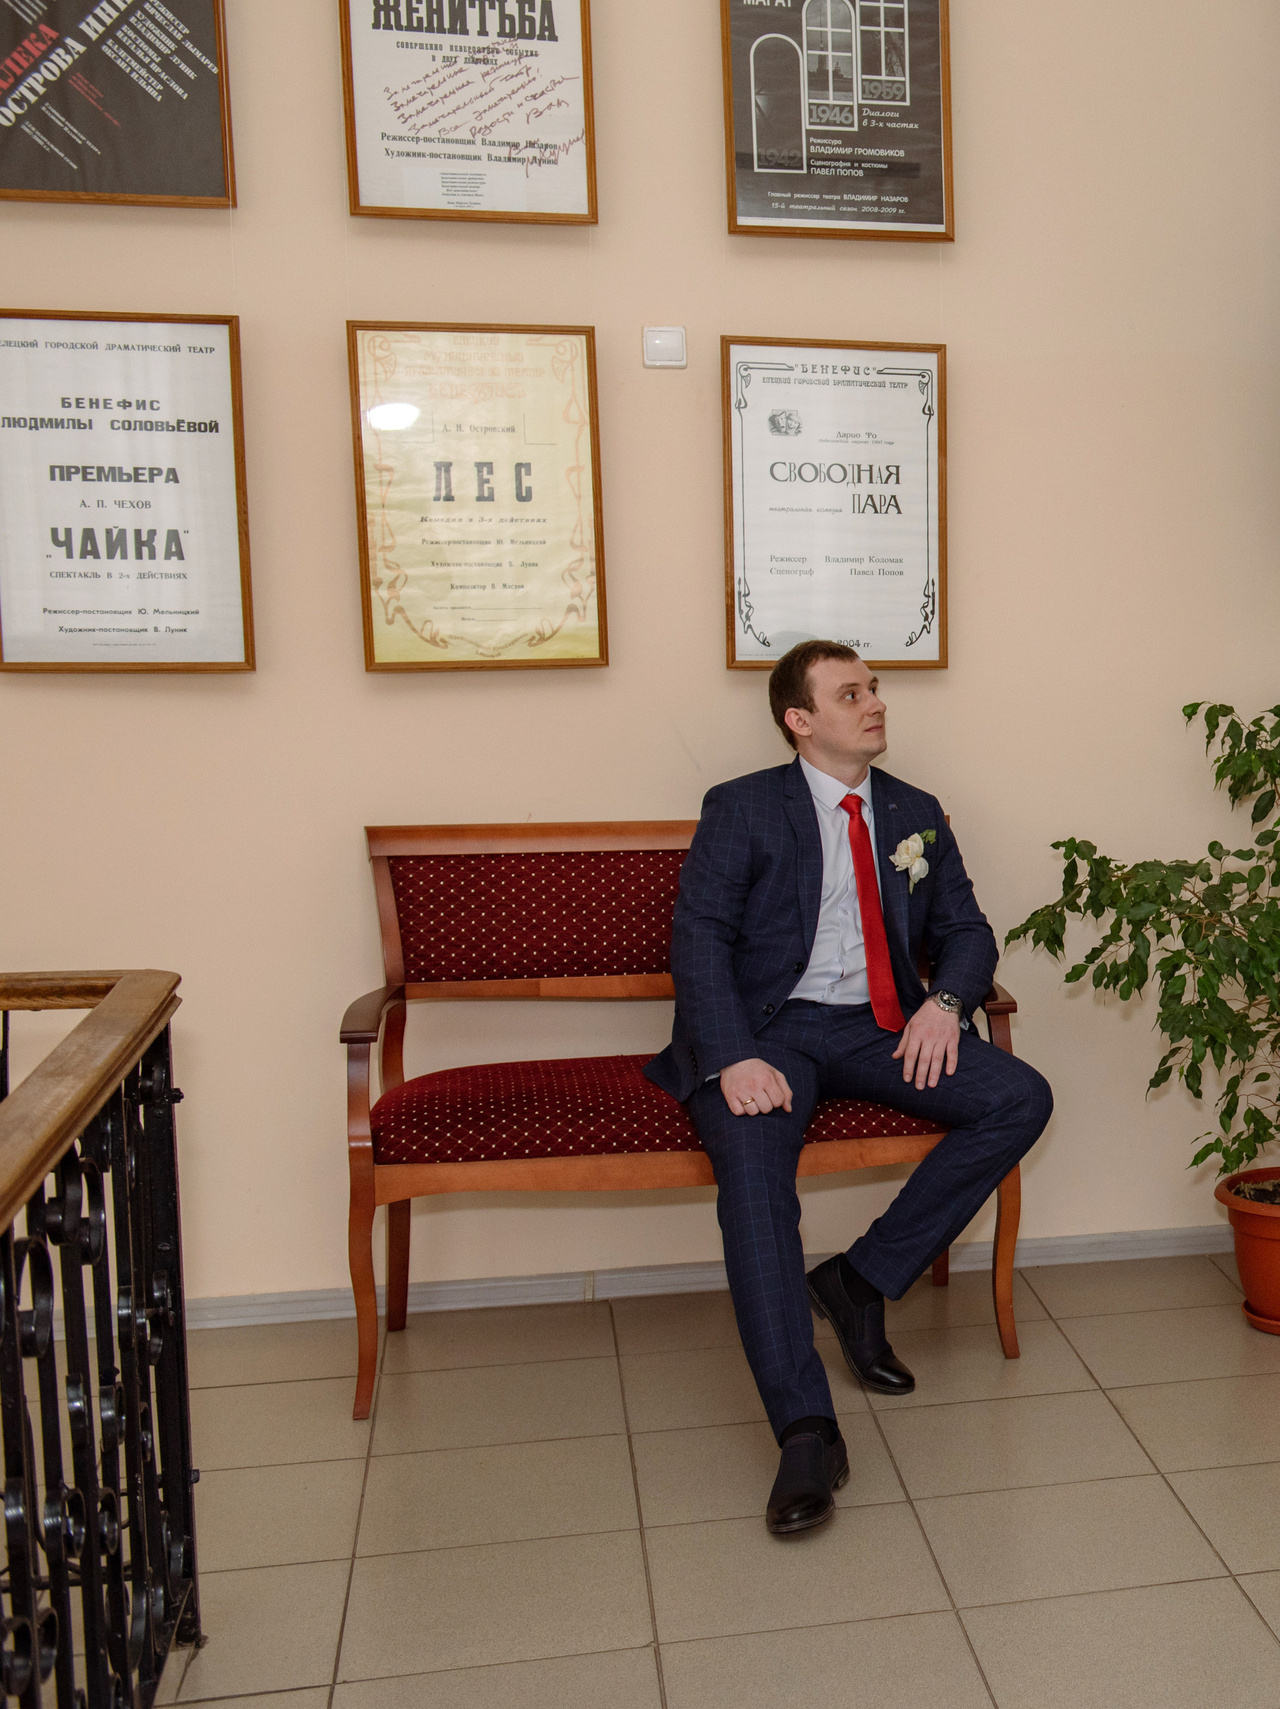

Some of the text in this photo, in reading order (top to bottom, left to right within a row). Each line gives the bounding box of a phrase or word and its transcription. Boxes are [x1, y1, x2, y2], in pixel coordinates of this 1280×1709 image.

[372, 0, 558, 42] ЖЕНИТЬБА
[135, 9, 178, 51] ХУДОЖНИК
[120, 23, 161, 63] КОСТЮМЫ
[143, 2, 219, 74] ВЯЧЕСЛАВ ЛЫМАРЕВ
[128, 15, 197, 80] ВЛАДИМИР ЛУНИК
[396, 41, 443, 52] СОВЕРШЕННО
[105, 38, 164, 90] БАЛЕТМЕЙСТЕР
[115, 29, 151, 64] НАТАЛЬЯ
[148, 61, 188, 100] ПРАСЛОВА
[441, 55, 458, 63] ДВУХ
[101, 44, 131, 73] ОКСАНА
[130, 71, 162, 102] ИЛЬИНА
[862, 81, 905, 100] 1959
[809, 105, 853, 125] 1946
[862, 107, 900, 117] Диалоги
[862, 118, 868, 127] в
[886, 121, 919, 129] частях
[381, 132, 476, 147] Режиссер-постановщик
[481, 138, 520, 150] Владимир
[810, 137, 842, 146] Режиссура
[384, 148, 482, 162] Художник-постановщик
[487, 153, 526, 165] Владимир
[758, 149, 801, 167] 1942
[810, 146, 905, 157] ВЛАДИМИР ГРОМОВИКОВ
[810, 159, 852, 168] Сценография
[810, 167, 864, 177] ПАВЕЛ ПОПОВ
[843, 193, 878, 201] ВЛАДИМИР
[880, 195, 909, 203] НАЗАРОВ
[861, 205, 897, 213] 2008-2009
[45, 340, 99, 351] ГОРОДСКОЙ
[105, 343, 181, 353] ДРАМАТИЧЕСКИЙ
[187, 345, 215, 354] ТЕАТР
[793, 378, 830, 386] ГОРОДСКОЙ
[889, 381, 909, 389] ТЕАТР
[61, 397, 161, 411] БЕНЕФИС
[1, 416, 219, 434] ЛЮДМИЛЫ СОЛОВЬЁВОЙ
[469, 424, 516, 434] Островский
[49, 464, 180, 484] ПРЕМЬЕРА
[769, 461, 901, 488] СВОБОДНАЯ
[433, 461, 533, 502] ЛЕС
[79, 500, 152, 509] А. П. ЧЕХОВ
[852, 493, 903, 514] ПАРА
[769, 554, 904, 564] Режиссер Владимир Коломак
[50, 571, 101, 579] СПЕКТАКЛЬ
[136, 571, 187, 580] ДЕЙСТВИЯХ
[769, 567, 904, 577] Сценограф Павел Попов
[43, 607, 132, 616] Режиссер-постановщик
[153, 608, 200, 616] Мельницкий
[58, 626, 148, 634] Художник-постановщик
[165, 626, 187, 634] Луник
